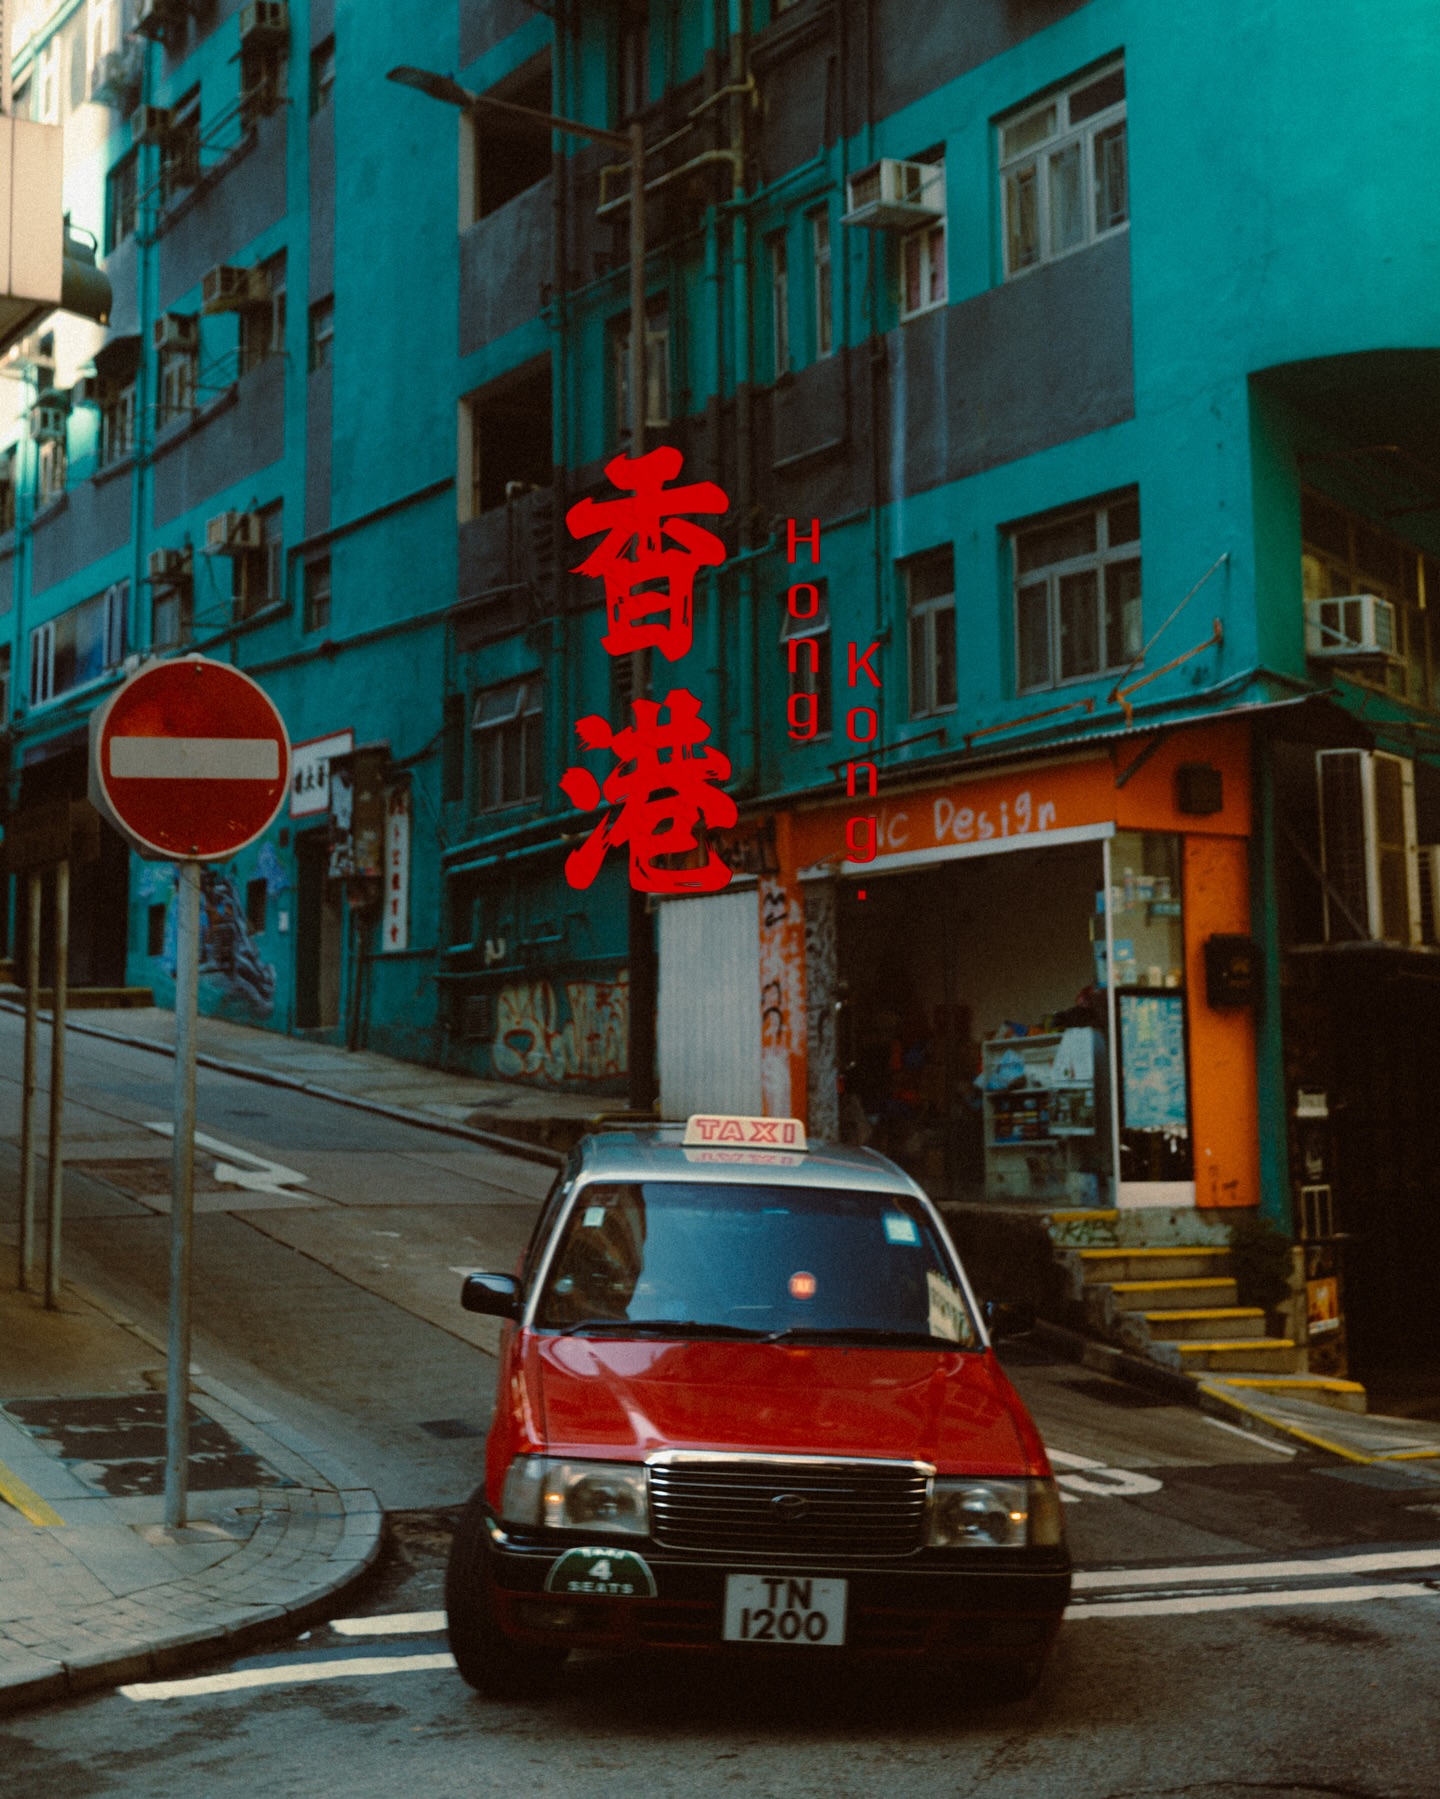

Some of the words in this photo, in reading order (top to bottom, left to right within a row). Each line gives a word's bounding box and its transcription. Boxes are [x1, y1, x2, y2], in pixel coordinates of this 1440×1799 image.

[933, 791, 1057, 842] Design
[695, 1118, 796, 1144] TAXI
[588, 1559, 613, 1581] 4
[567, 1581, 634, 1595] SEATS
[761, 1577, 812, 1610] TN
[740, 1607, 828, 1642] 1200
